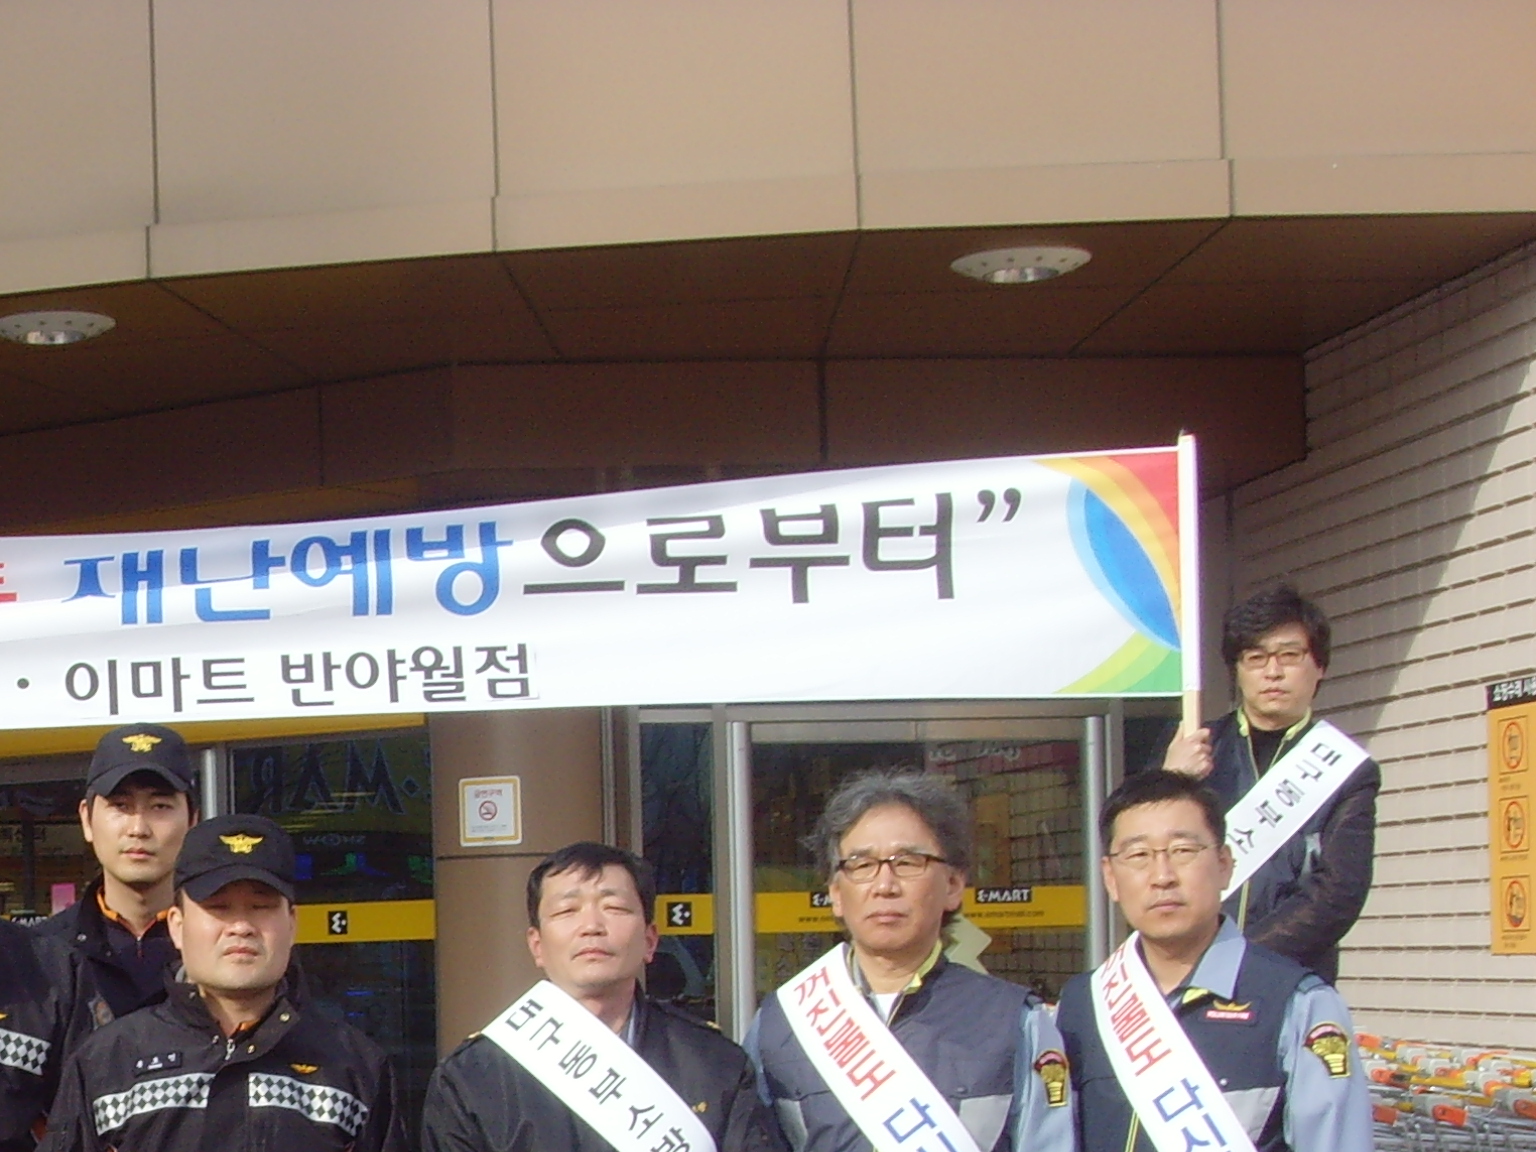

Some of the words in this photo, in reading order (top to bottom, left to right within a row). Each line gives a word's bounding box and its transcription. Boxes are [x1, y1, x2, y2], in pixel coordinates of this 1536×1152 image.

[64, 647, 256, 716] 이마트
[280, 641, 533, 708] 반야월점
[793, 965, 896, 1100] 꺼진불도
[1100, 943, 1172, 1077] 꺼진불도
